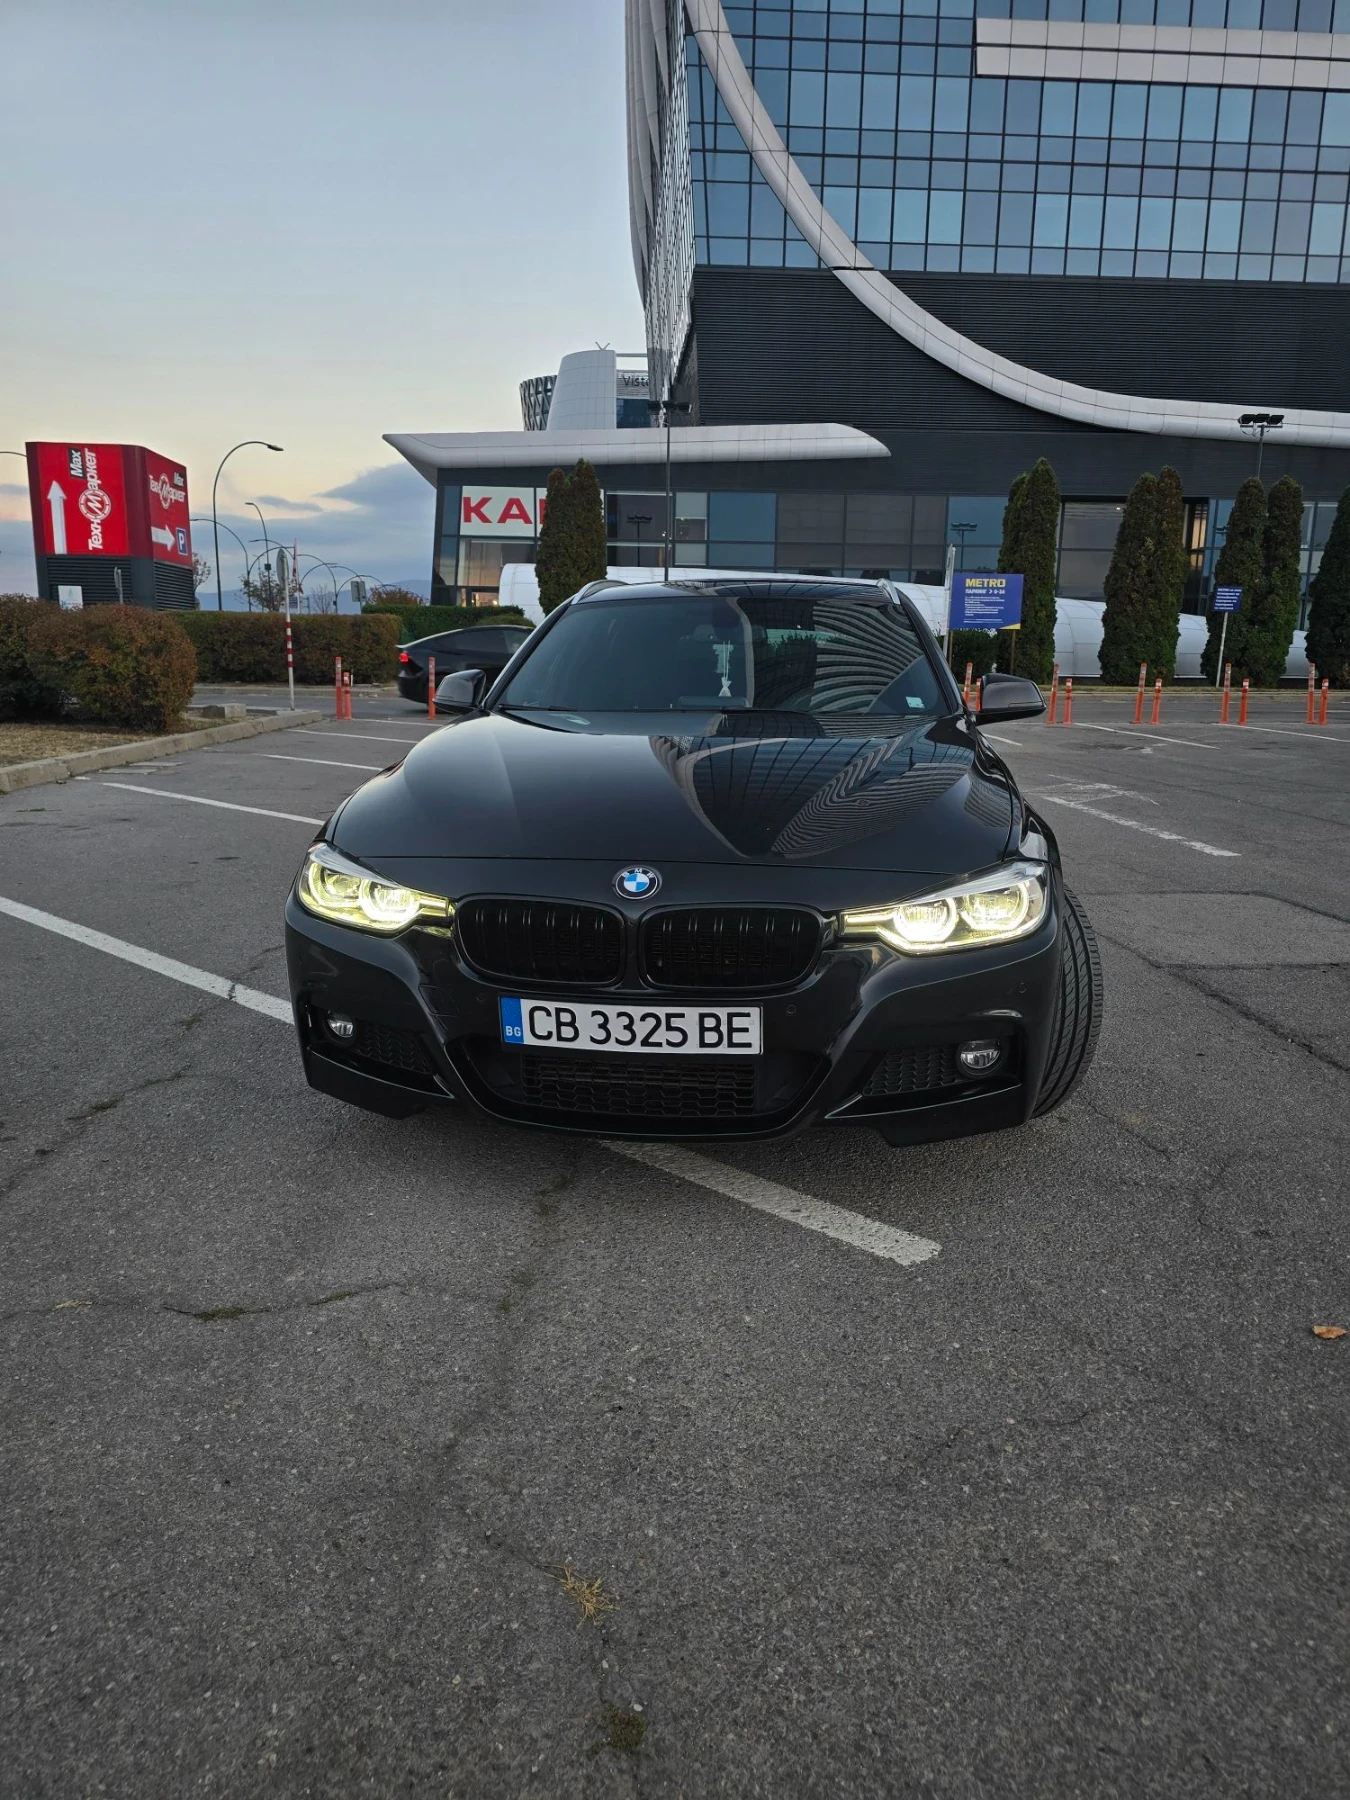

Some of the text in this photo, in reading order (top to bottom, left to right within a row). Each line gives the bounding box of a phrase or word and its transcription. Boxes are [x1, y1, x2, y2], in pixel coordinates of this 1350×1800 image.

[70, 449, 83, 477] Max
[174, 472, 184, 487] Max
[178, 532, 185, 550] P
[965, 578, 1006, 588] METRO
[620, 867, 655, 878] BMW
[505, 1025, 522, 1037] BG
[528, 1005, 752, 1049] CB 3325 BE
